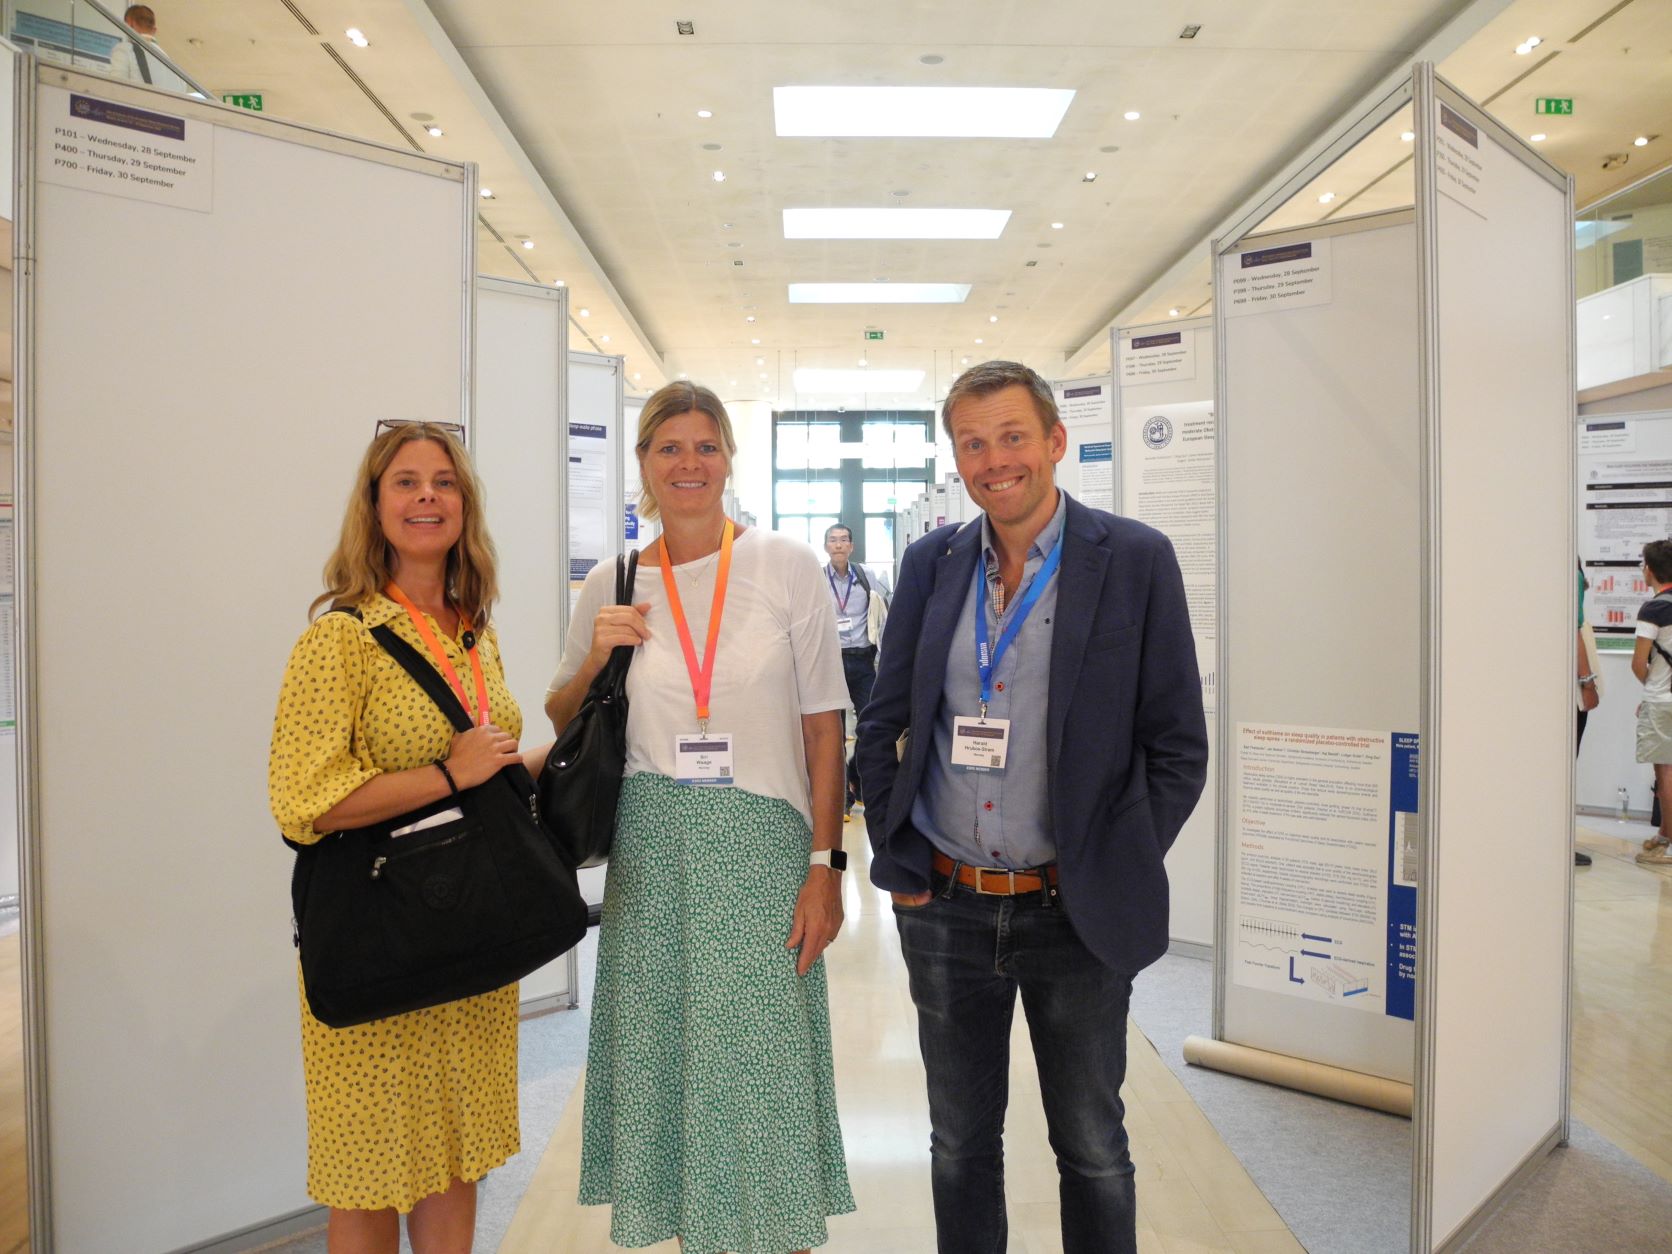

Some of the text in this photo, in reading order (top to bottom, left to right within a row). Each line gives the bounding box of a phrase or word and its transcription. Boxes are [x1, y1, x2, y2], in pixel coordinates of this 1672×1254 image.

[54, 127, 78, 139] P101
[88, 134, 139, 152] Wednesday,
[141, 145, 152, 154] 28
[153, 148, 196, 164] September
[54, 143, 78, 154] P400
[88, 150, 128, 166] Thursday,
[130, 158, 141, 167] 29
[144, 162, 186, 176] September
[54, 158, 78, 170] P700
[86, 165, 116, 178] Friday,
[117, 171, 128, 179] 30
[130, 174, 174, 189] September
[1292, 266, 1320, 275] September
[1285, 278, 1313, 287] September
[1277, 290, 1305, 298] September
